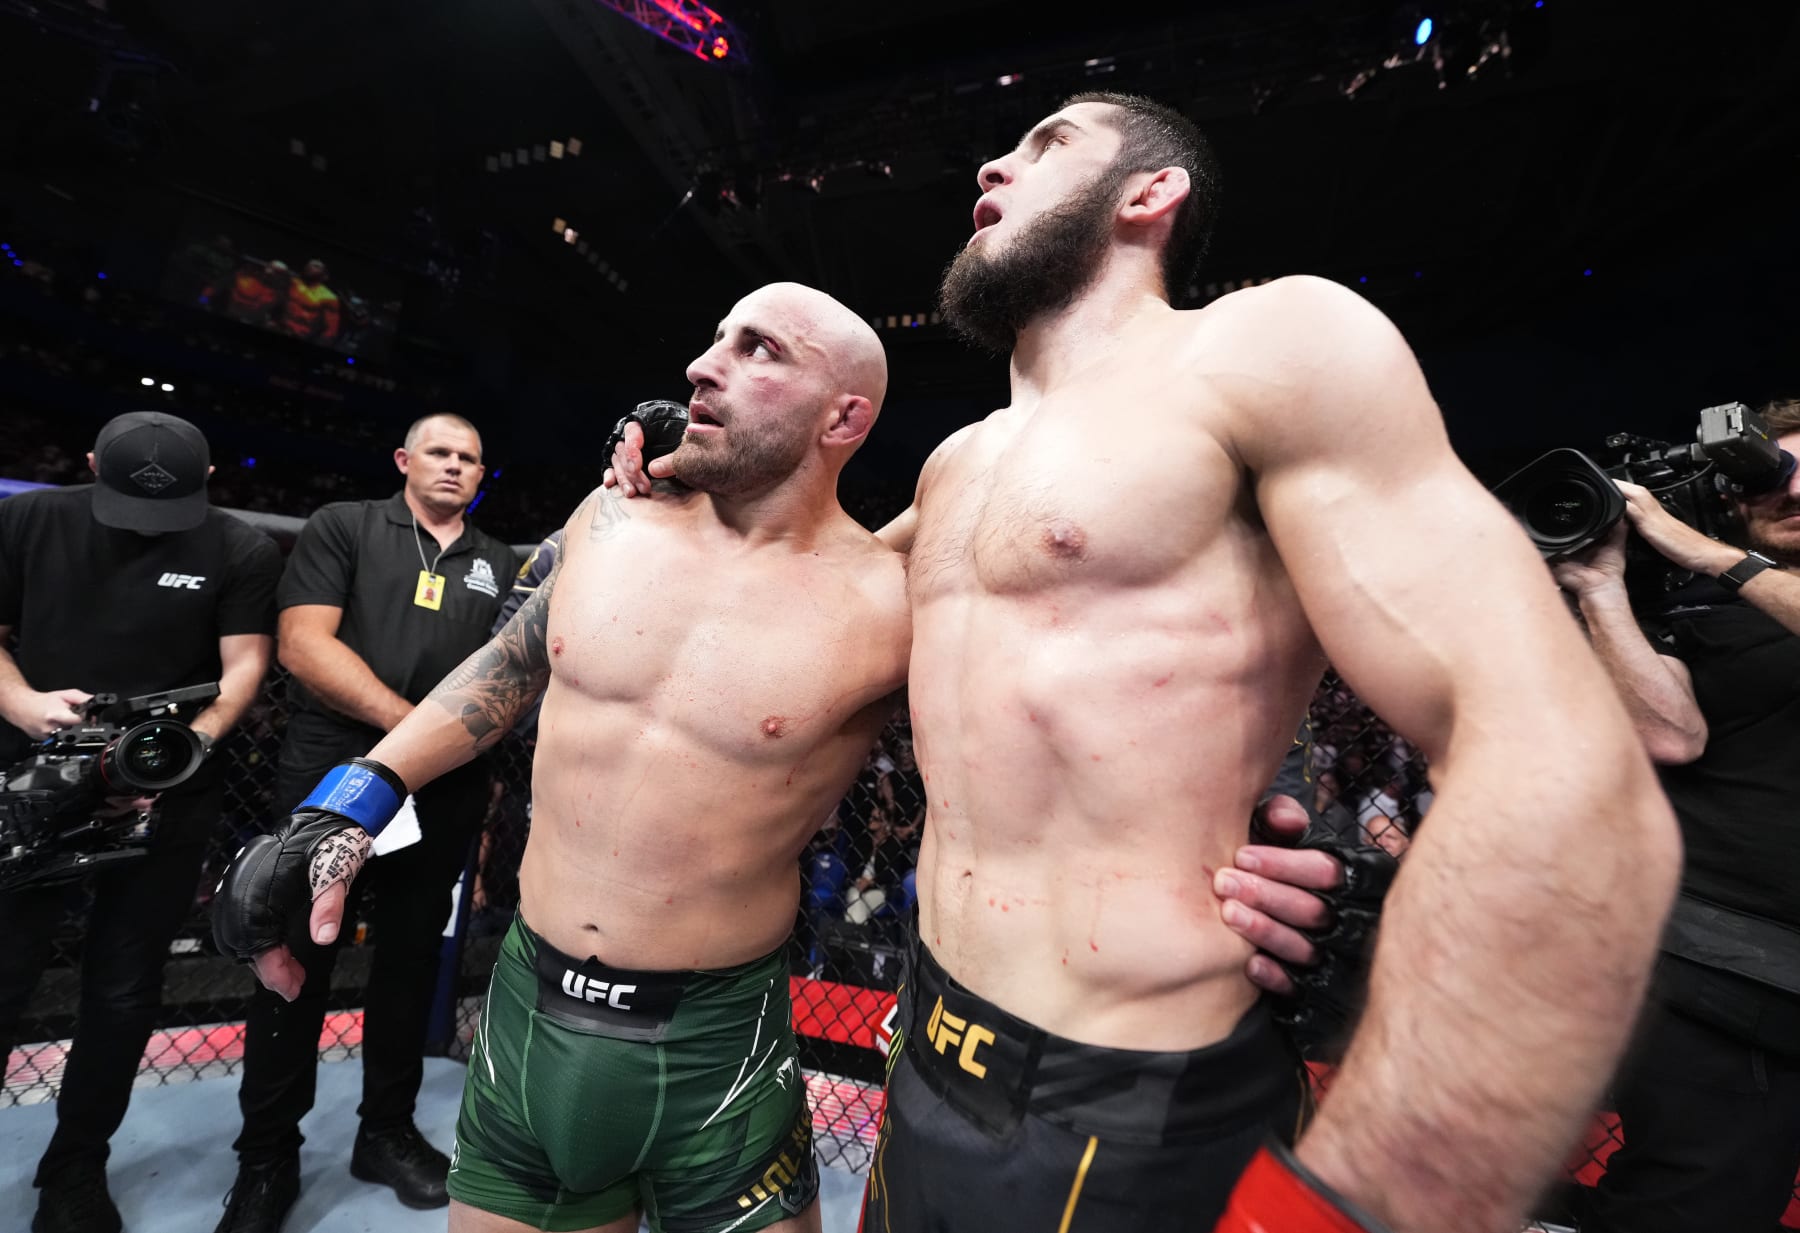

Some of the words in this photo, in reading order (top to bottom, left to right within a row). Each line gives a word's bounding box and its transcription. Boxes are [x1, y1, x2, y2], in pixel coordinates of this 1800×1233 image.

[157, 572, 206, 590] UFC
[561, 968, 637, 1011] UFC
[926, 994, 996, 1080] UFC
